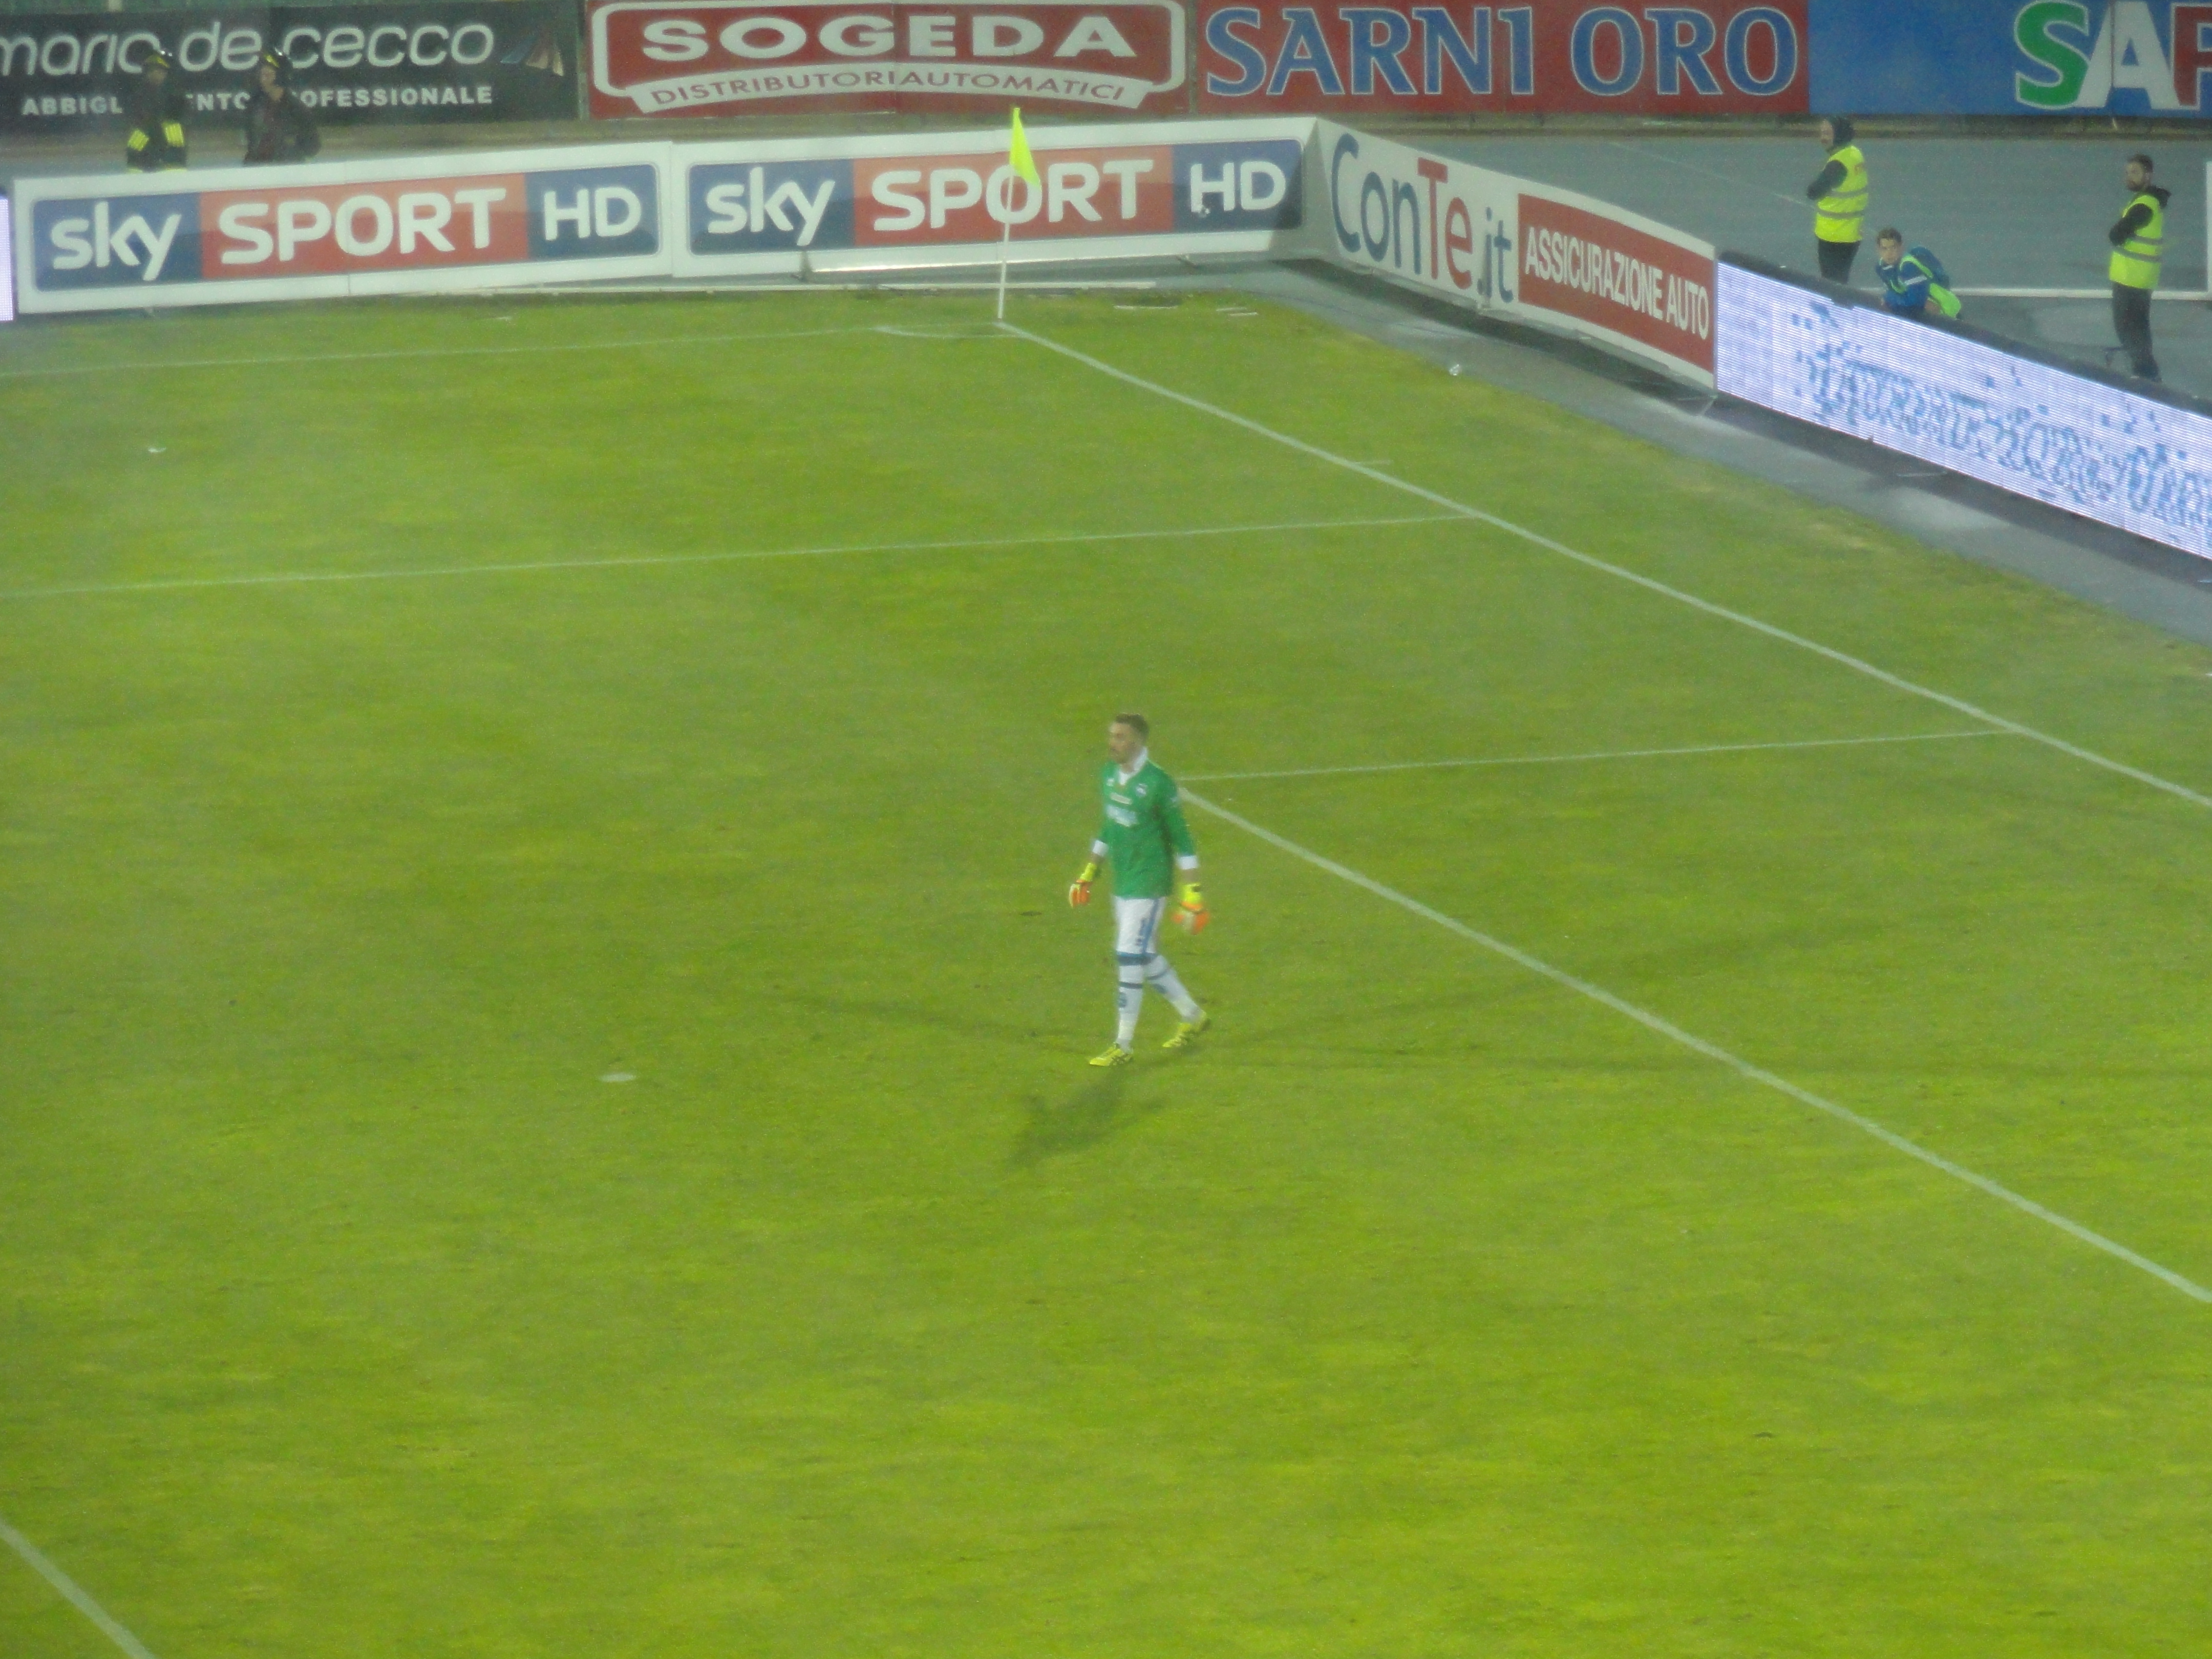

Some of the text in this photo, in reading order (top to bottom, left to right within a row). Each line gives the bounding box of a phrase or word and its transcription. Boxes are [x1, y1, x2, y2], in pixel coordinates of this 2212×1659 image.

[179, 20, 262, 73] de
[283, 24, 495, 69] cecco
[643, 14, 1137, 61] SOGEDA
[1205, 6, 1798, 97] SARNI ORO
[50, 186, 642, 282] sky SPORT HD
[706, 159, 1286, 247] sky SPORT HD
[1331, 132, 1514, 303] ConTe.it
[1524, 226, 1709, 340] ASSICURAZIONE AUTO
